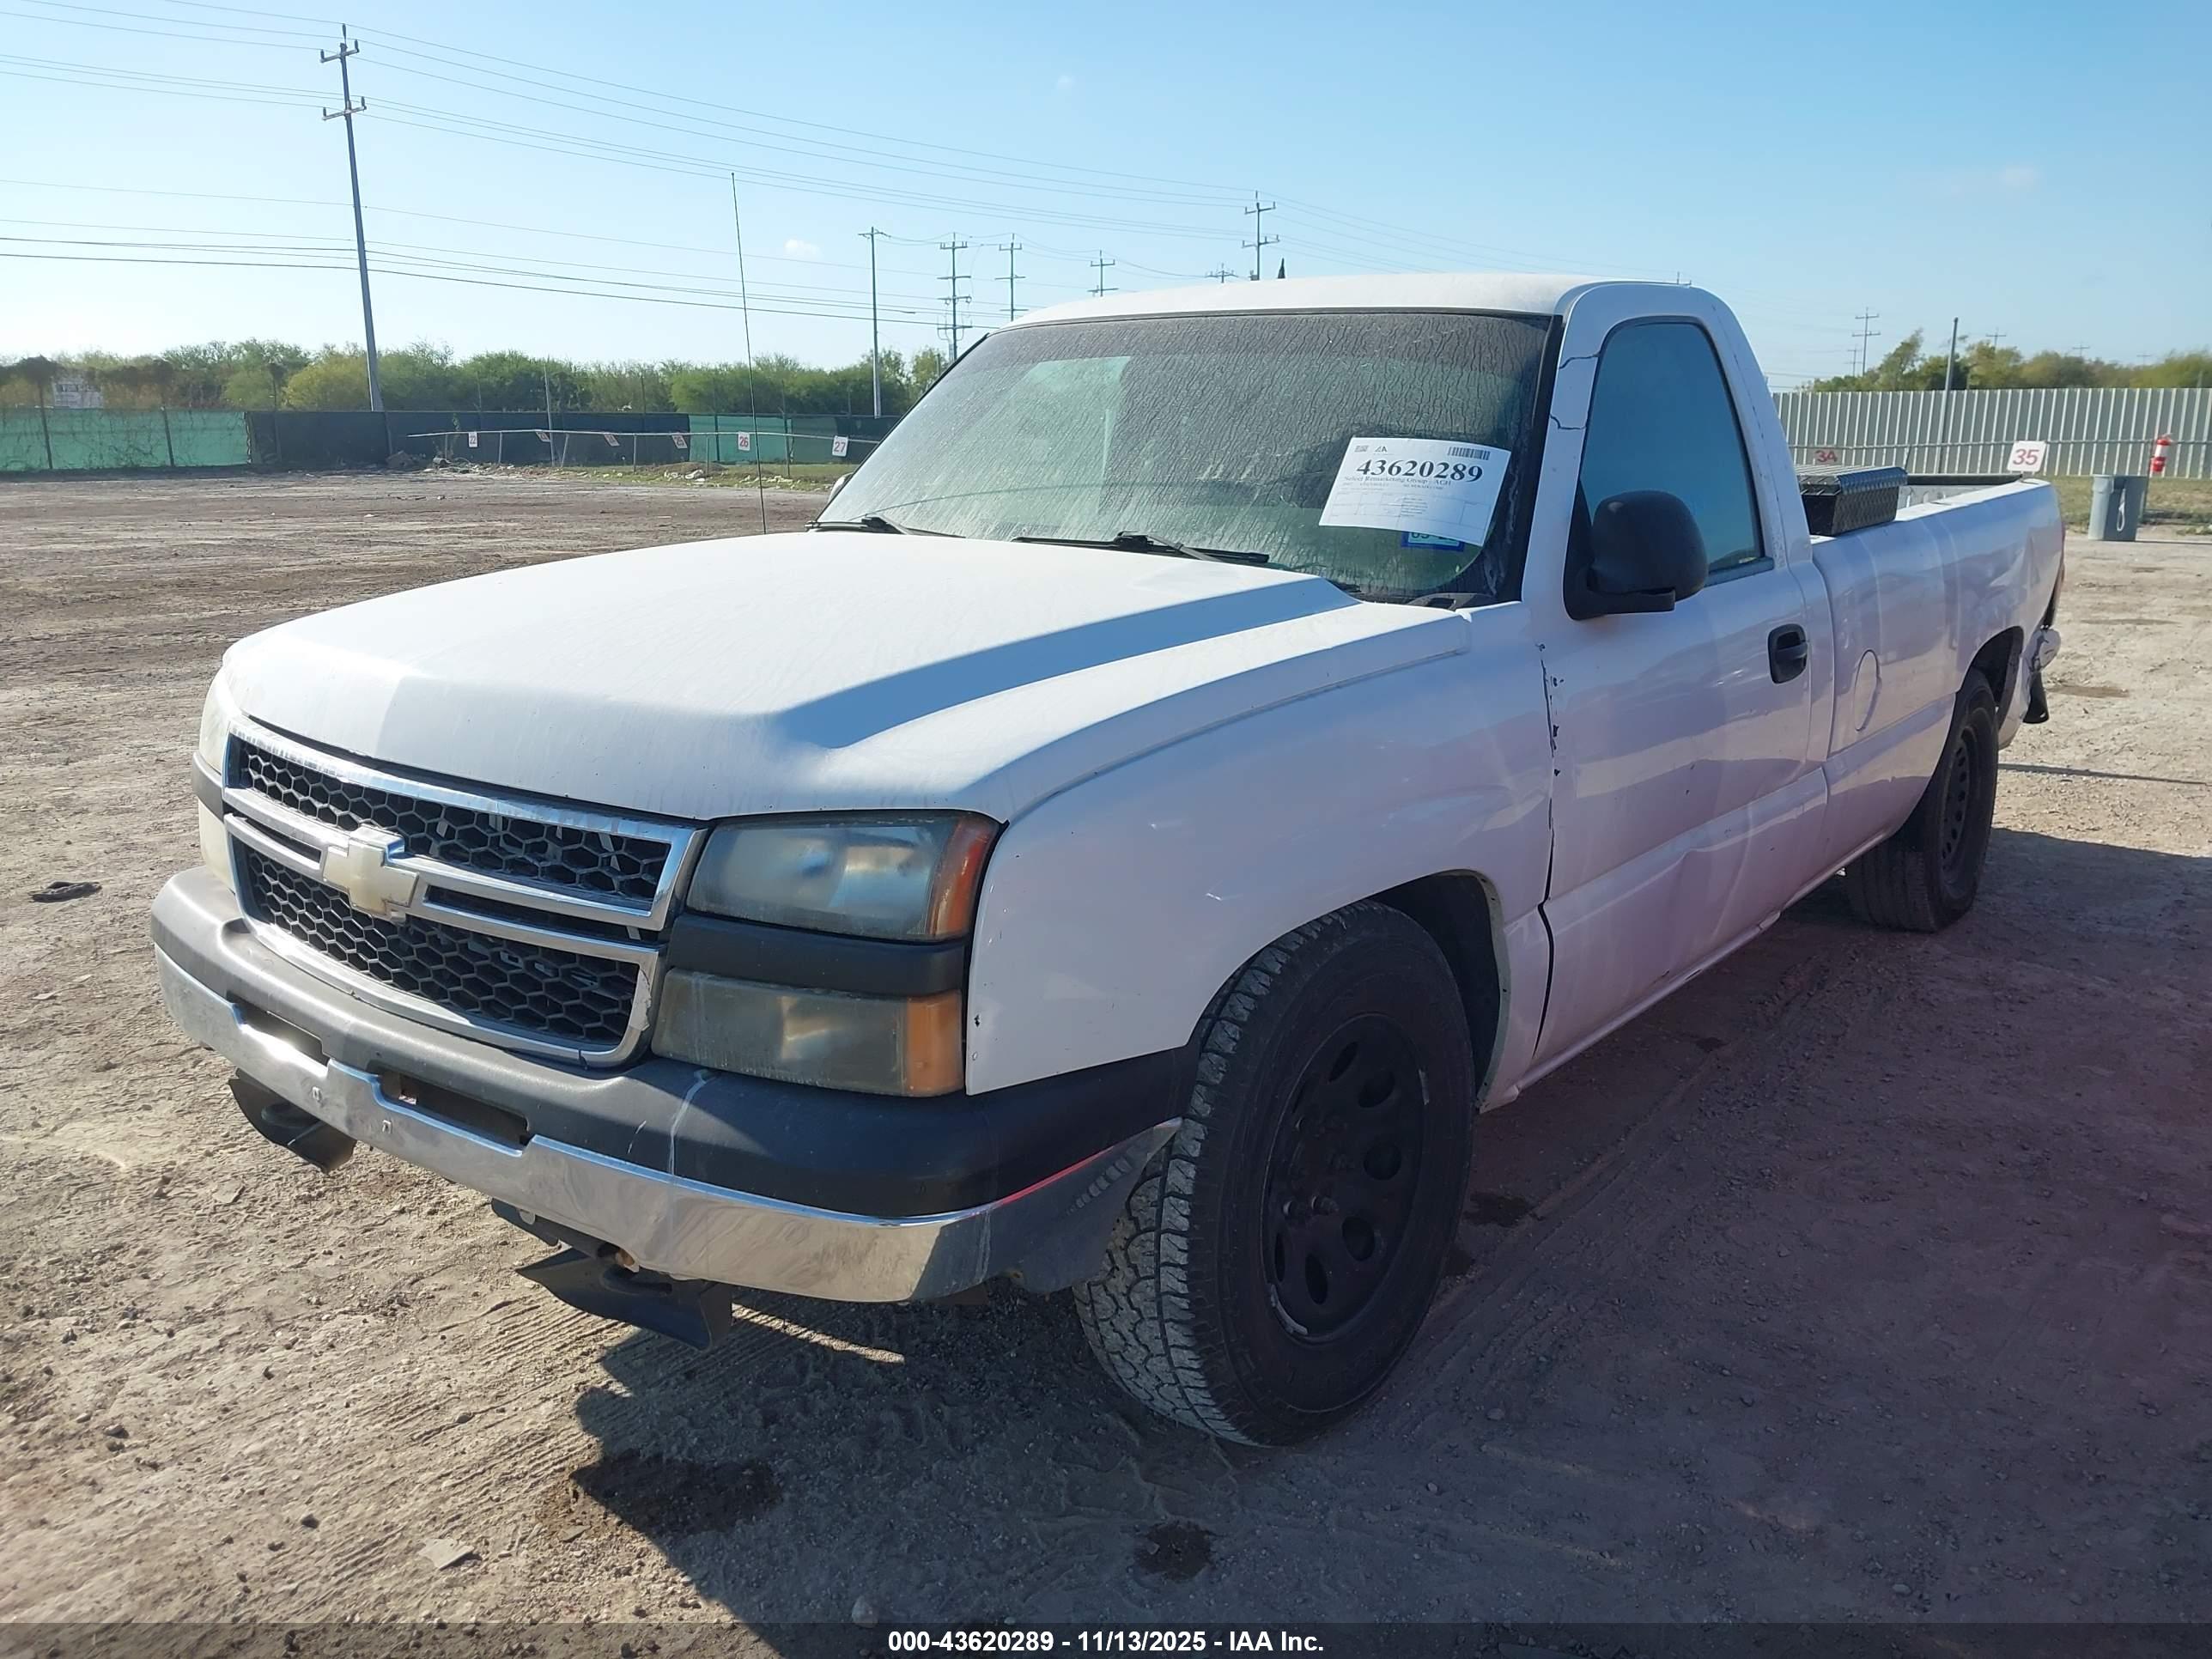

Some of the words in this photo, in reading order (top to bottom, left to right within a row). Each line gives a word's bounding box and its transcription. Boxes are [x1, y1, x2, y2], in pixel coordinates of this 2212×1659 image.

[470, 435, 477, 444] 22
[739, 436, 749, 447] 26
[834, 441, 846, 453] 27
[1815, 450, 1838, 463] 34
[2013, 448, 2039, 465] 35
[1357, 459, 1483, 482] 43620289
